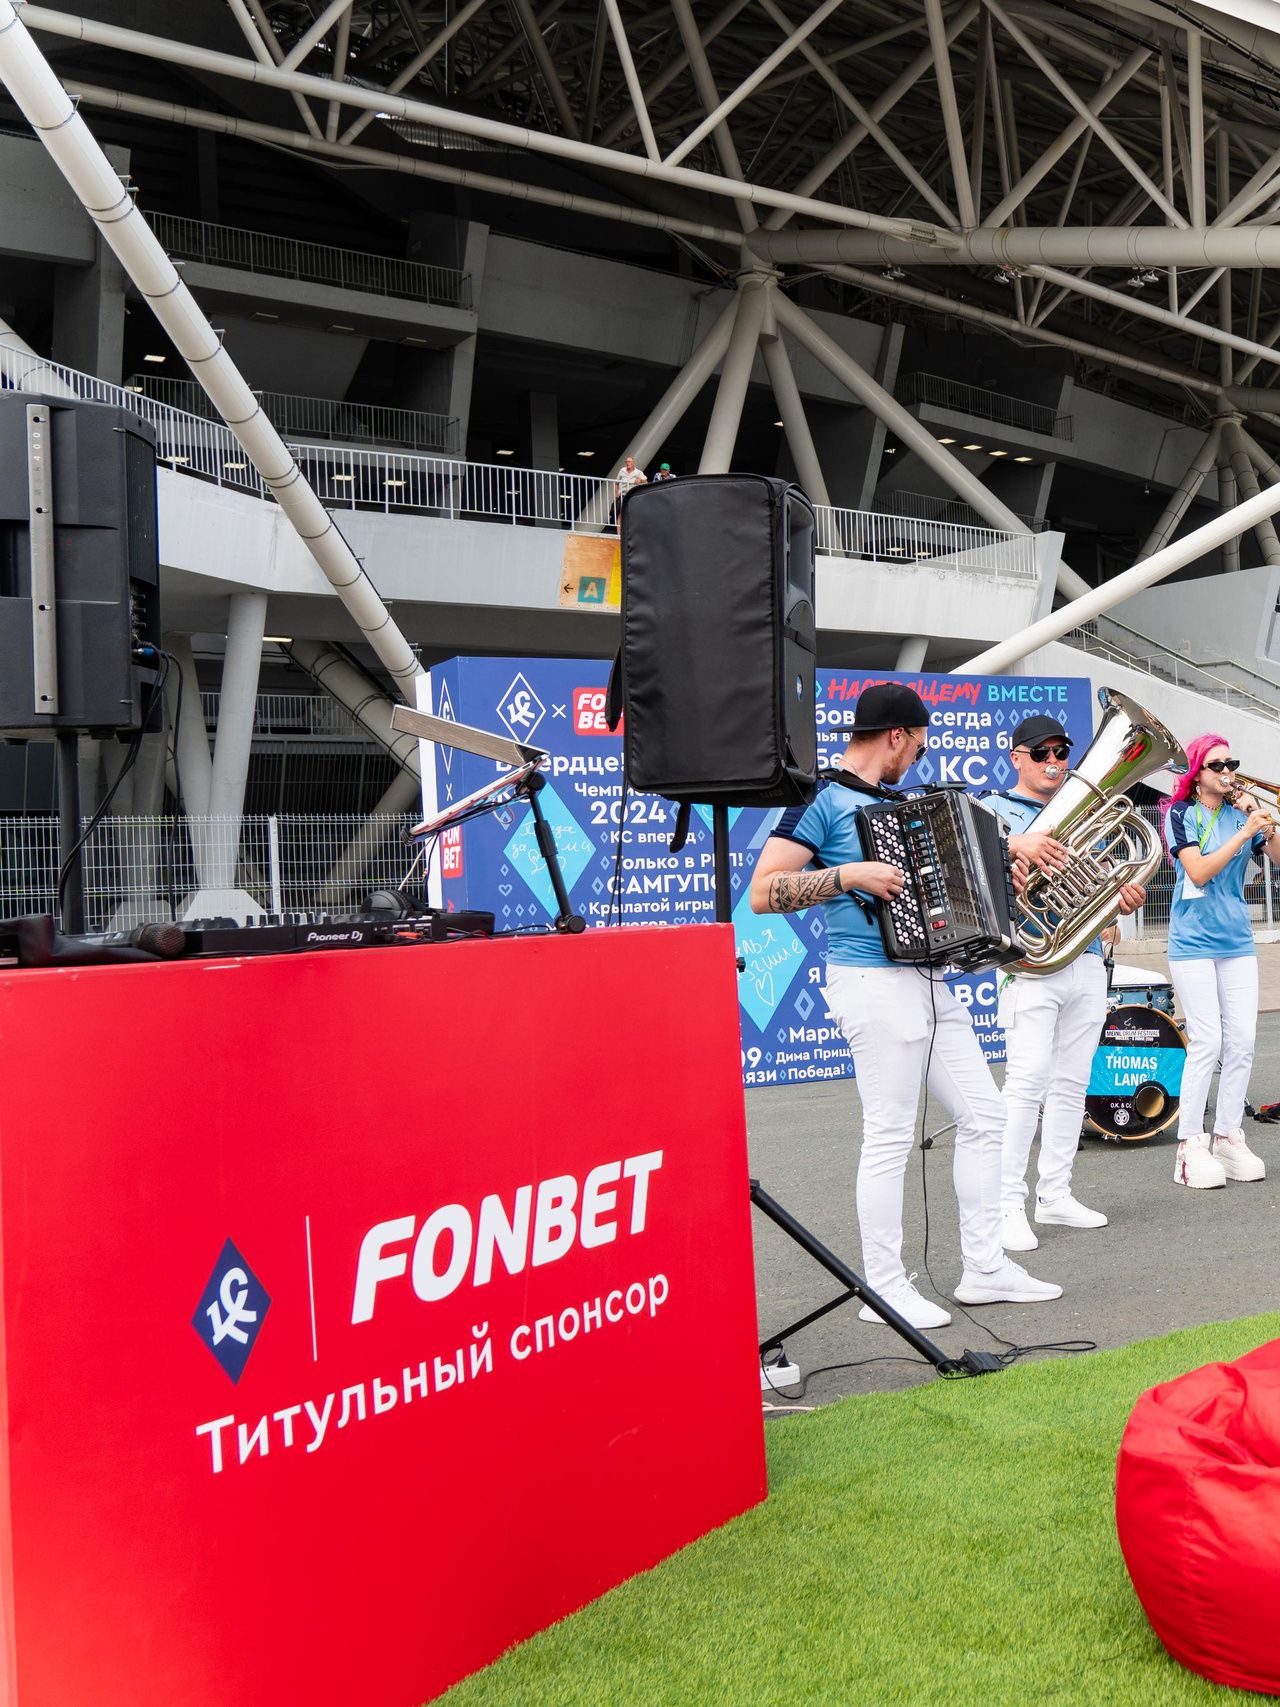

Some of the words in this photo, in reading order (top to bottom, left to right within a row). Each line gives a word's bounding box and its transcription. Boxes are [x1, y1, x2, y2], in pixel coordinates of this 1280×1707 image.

[577, 693, 607, 711] FO
[987, 685, 1068, 702] ВМЕСТЕ
[577, 711, 608, 729] BE
[930, 711, 992, 730] сегда
[924, 730, 990, 752] обеда
[538, 752, 625, 777] ердце!
[939, 755, 989, 786] КС
[590, 800, 667, 825] 2024
[610, 831, 633, 844] КС
[638, 832, 697, 846] вперд
[443, 845, 461, 870] BET
[589, 897, 670, 917] Крылатой
[674, 899, 714, 914] игры
[307, 932, 350, 942] Pioneer
[789, 1026, 844, 1044] Марк
[775, 1051, 810, 1065] Дима
[813, 1048, 853, 1061] Прищ
[1105, 1055, 1158, 1070] THOMAS
[788, 1063, 845, 1080] Победа!
[1114, 1073, 1148, 1087] LANG
[351, 1149, 664, 1325] FONBET
[195, 1321, 494, 1474] Титульный
[509, 1273, 670, 1361] спонсор
